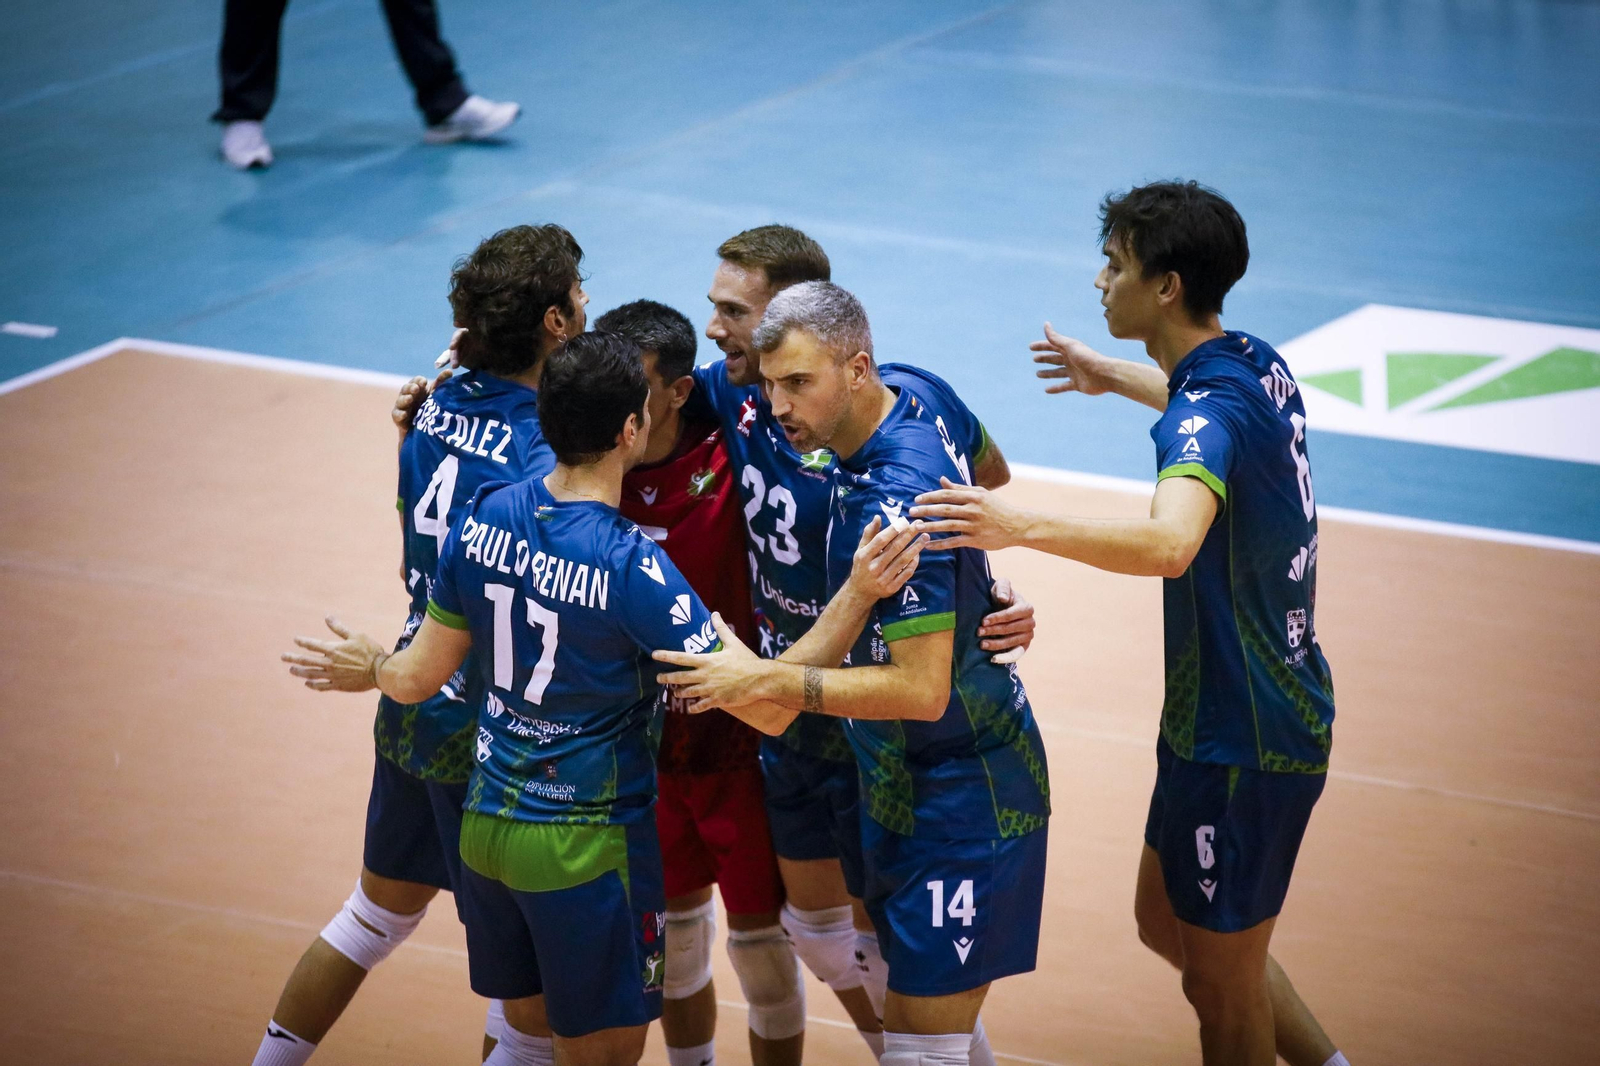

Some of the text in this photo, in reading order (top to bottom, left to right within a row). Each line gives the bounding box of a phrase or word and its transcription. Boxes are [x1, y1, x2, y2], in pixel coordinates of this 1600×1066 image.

[414, 454, 459, 561] 4
[741, 464, 801, 566] 23
[461, 515, 609, 611] PAULO RENAN
[484, 583, 559, 706] 17
[1195, 825, 1215, 869] 6
[927, 880, 976, 927] 14
